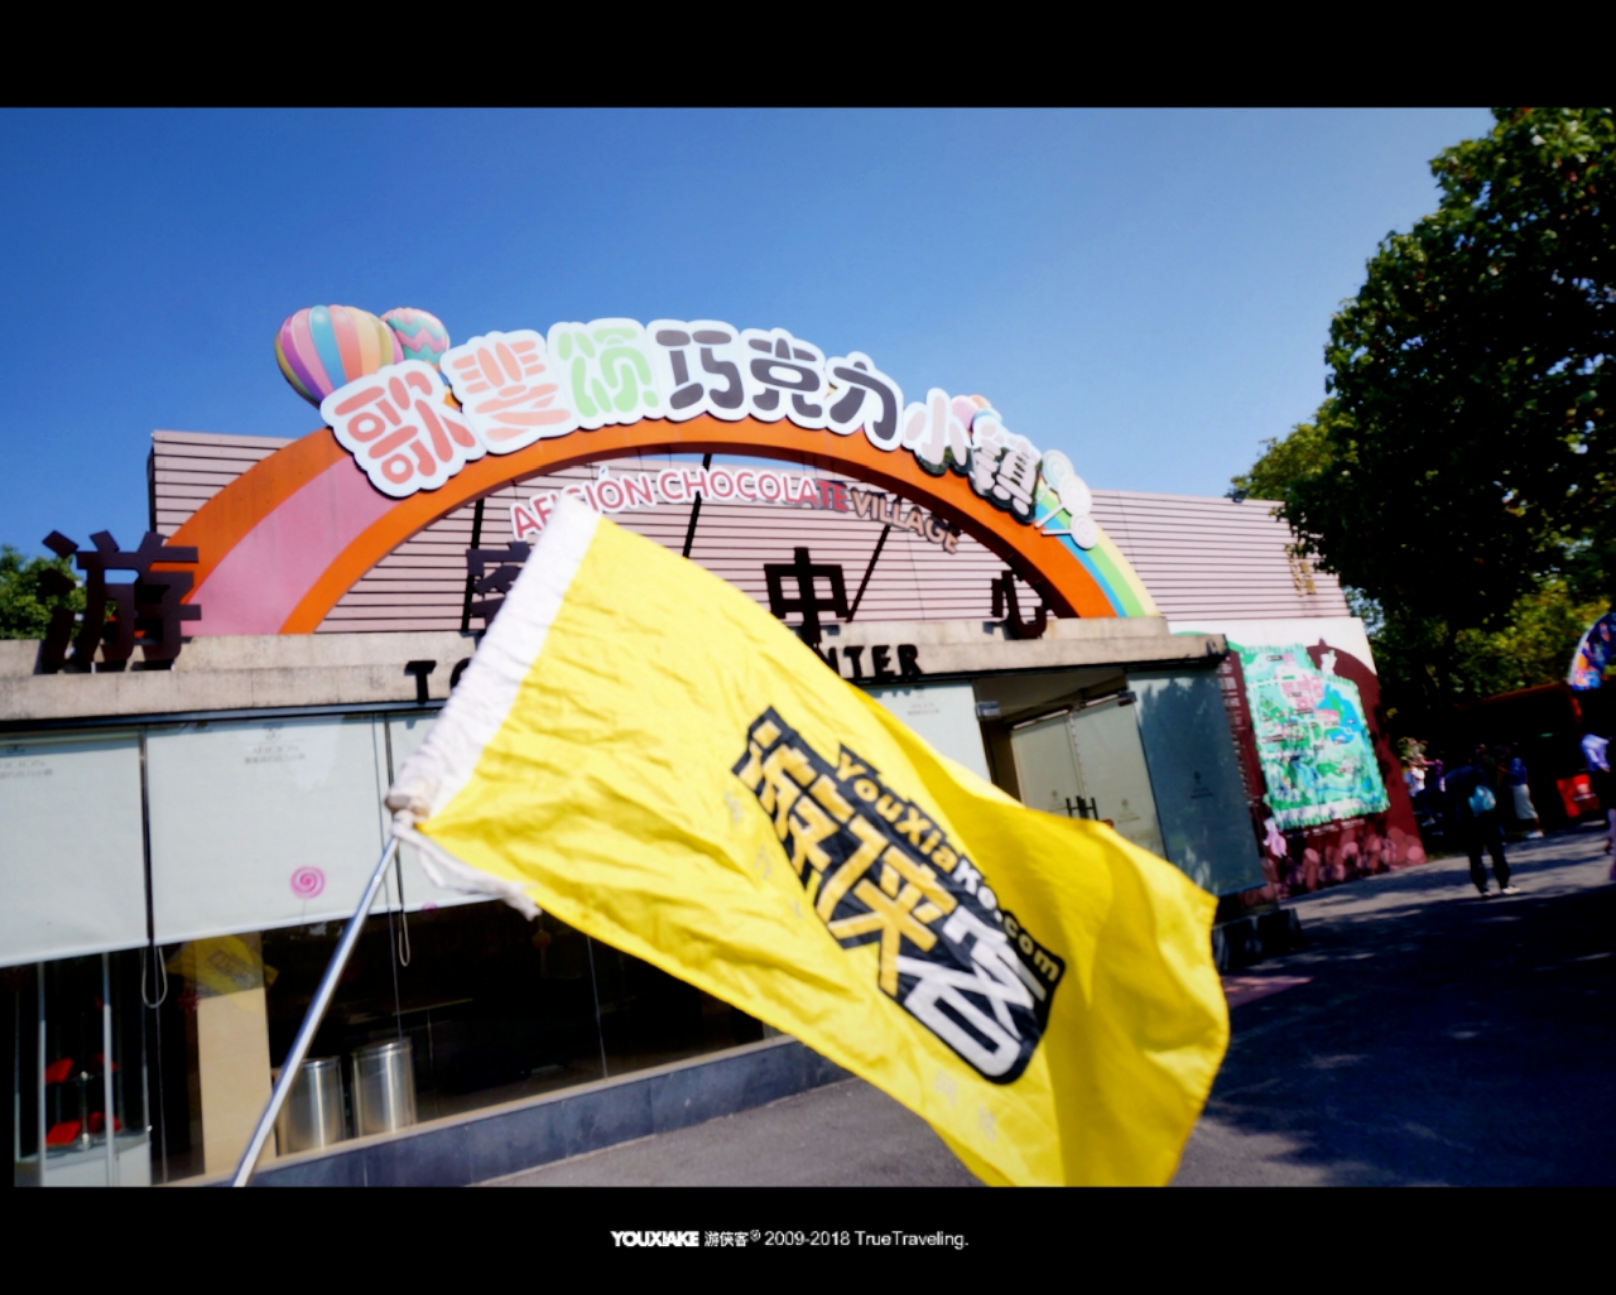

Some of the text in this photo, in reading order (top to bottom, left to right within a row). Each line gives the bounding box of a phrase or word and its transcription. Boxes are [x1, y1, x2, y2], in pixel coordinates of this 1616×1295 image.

[512, 469, 960, 554] AFIÓN CHOCOLATE VILLAGE
[815, 643, 923, 680] NTER
[737, 718, 1048, 1077] 游侠客
